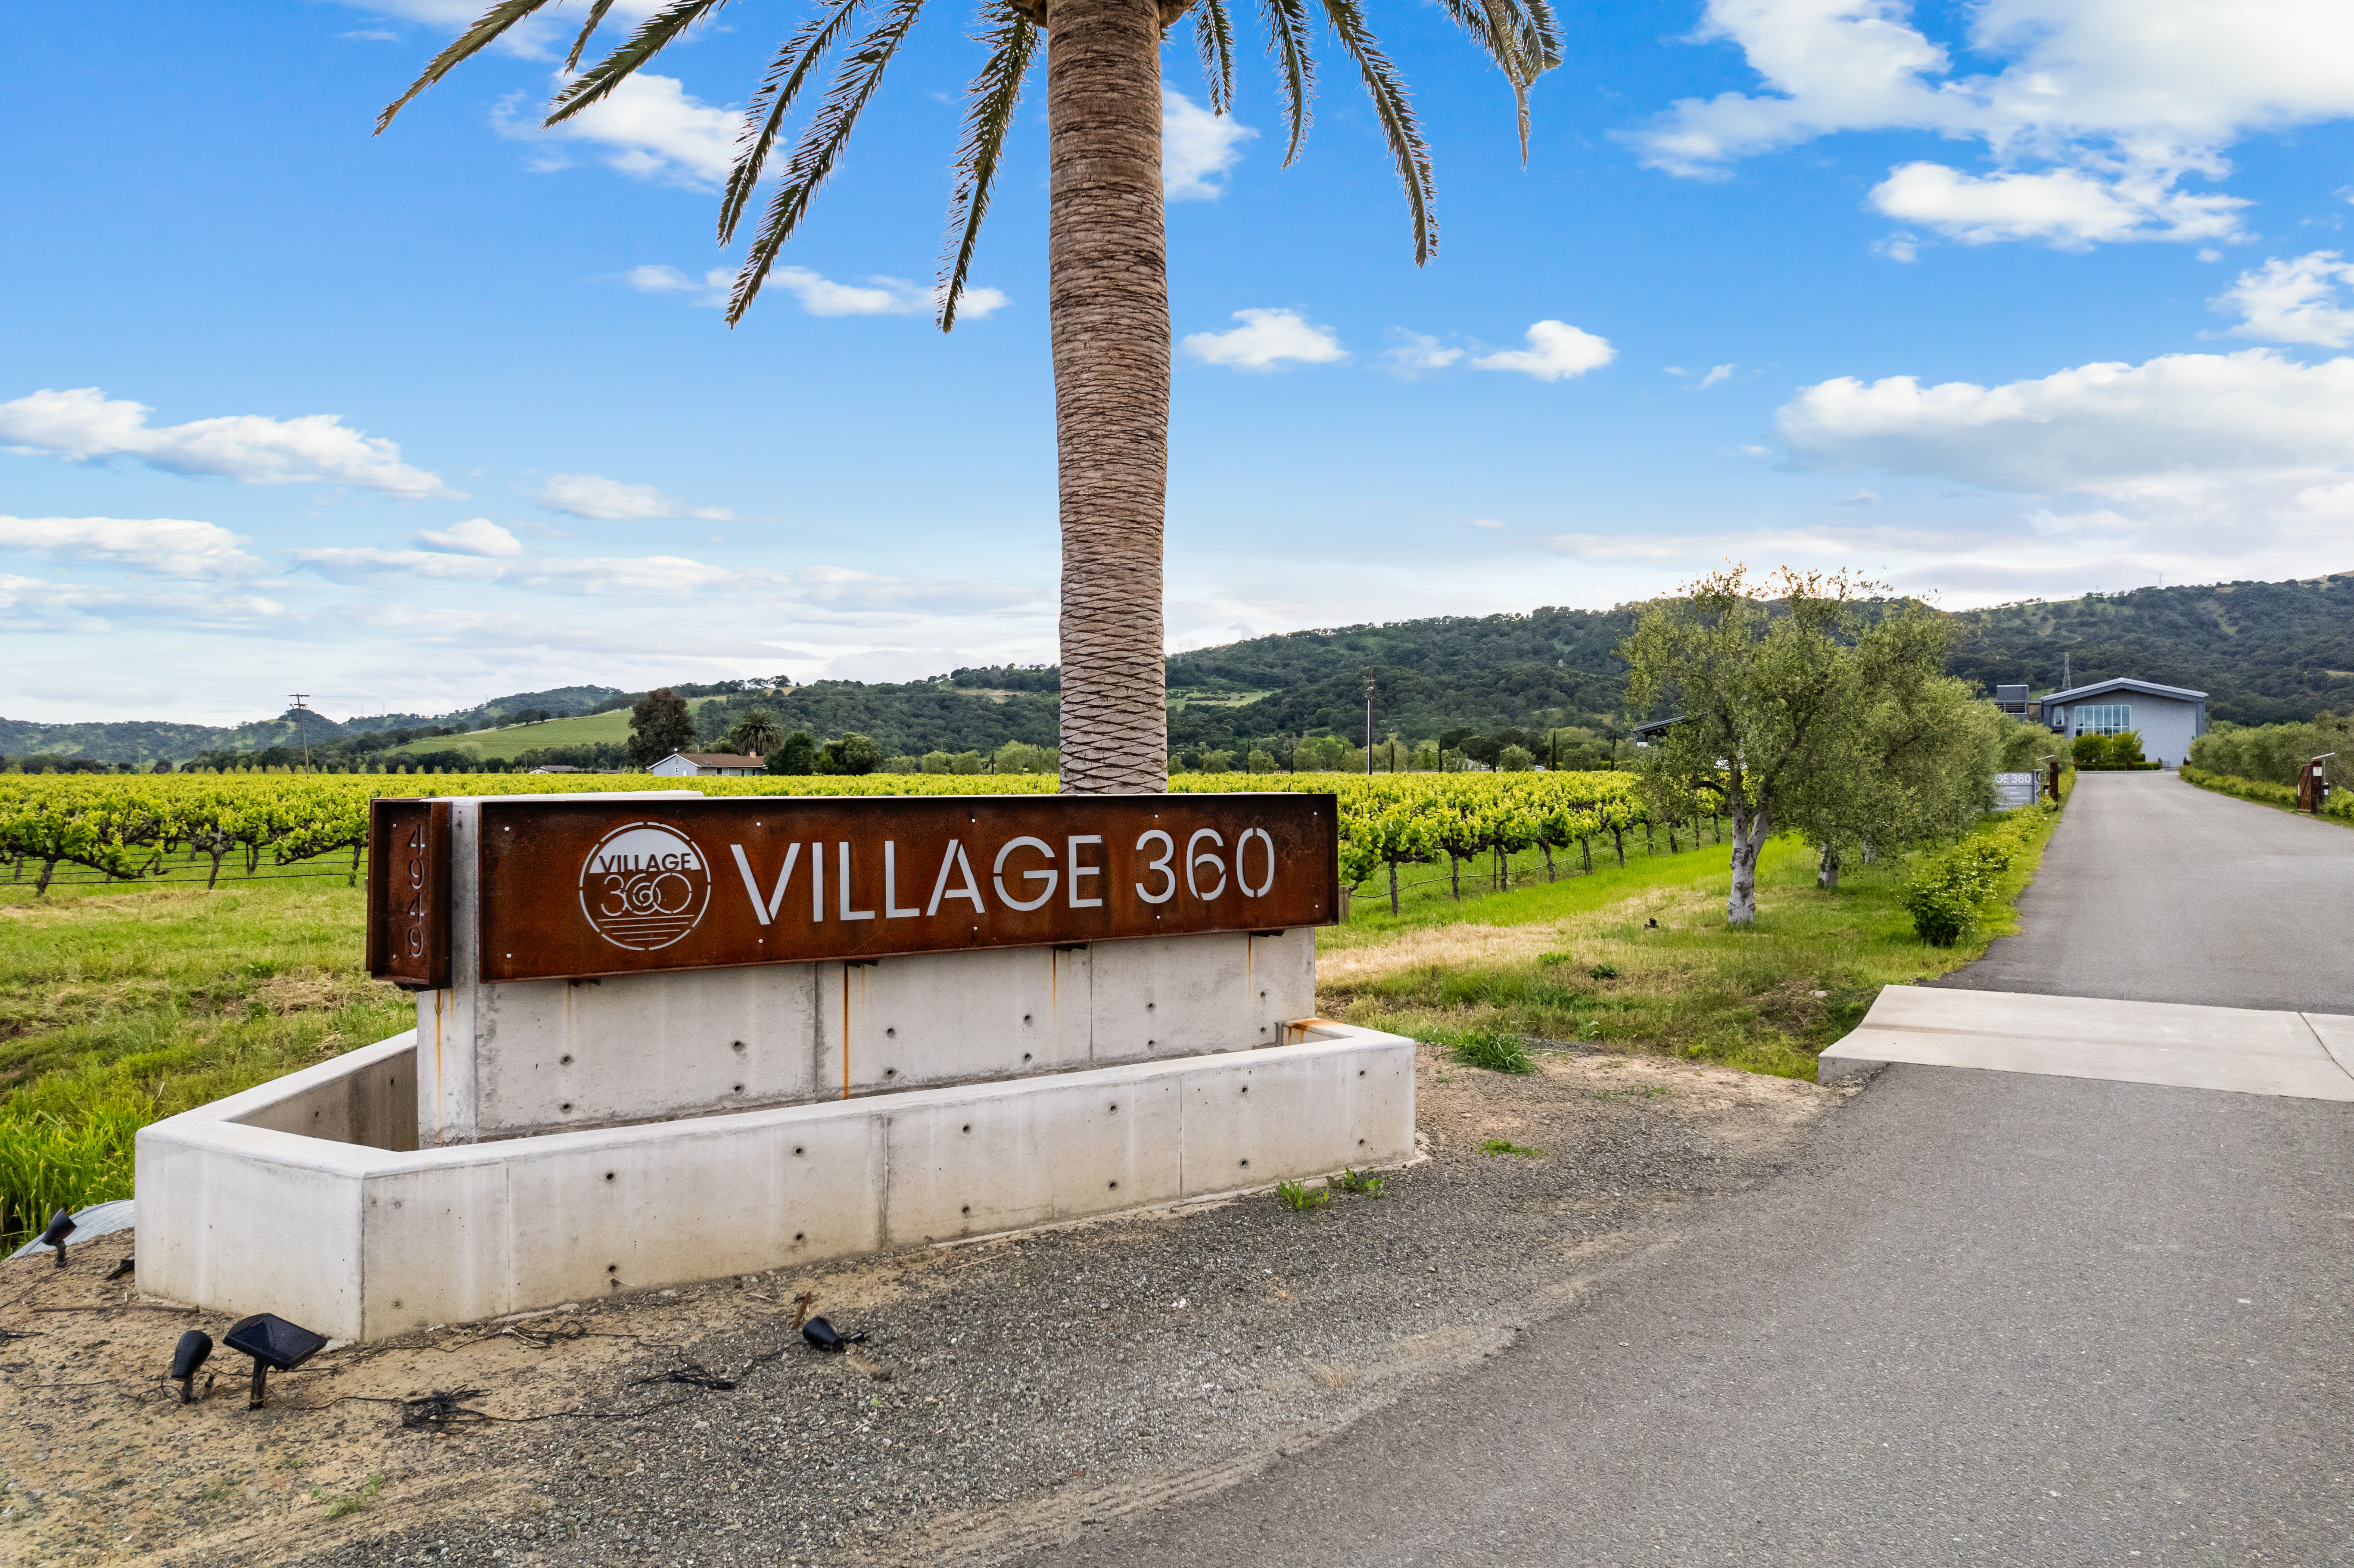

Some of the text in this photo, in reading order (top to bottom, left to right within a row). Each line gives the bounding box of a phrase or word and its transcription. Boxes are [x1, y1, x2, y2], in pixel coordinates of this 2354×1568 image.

[1993, 774, 2031, 783] GE 360
[599, 853, 691, 873] VILLAGE
[730, 827, 1276, 925] VILLAGE 360
[408, 823, 426, 958] 4949
[601, 872, 692, 916] 360
